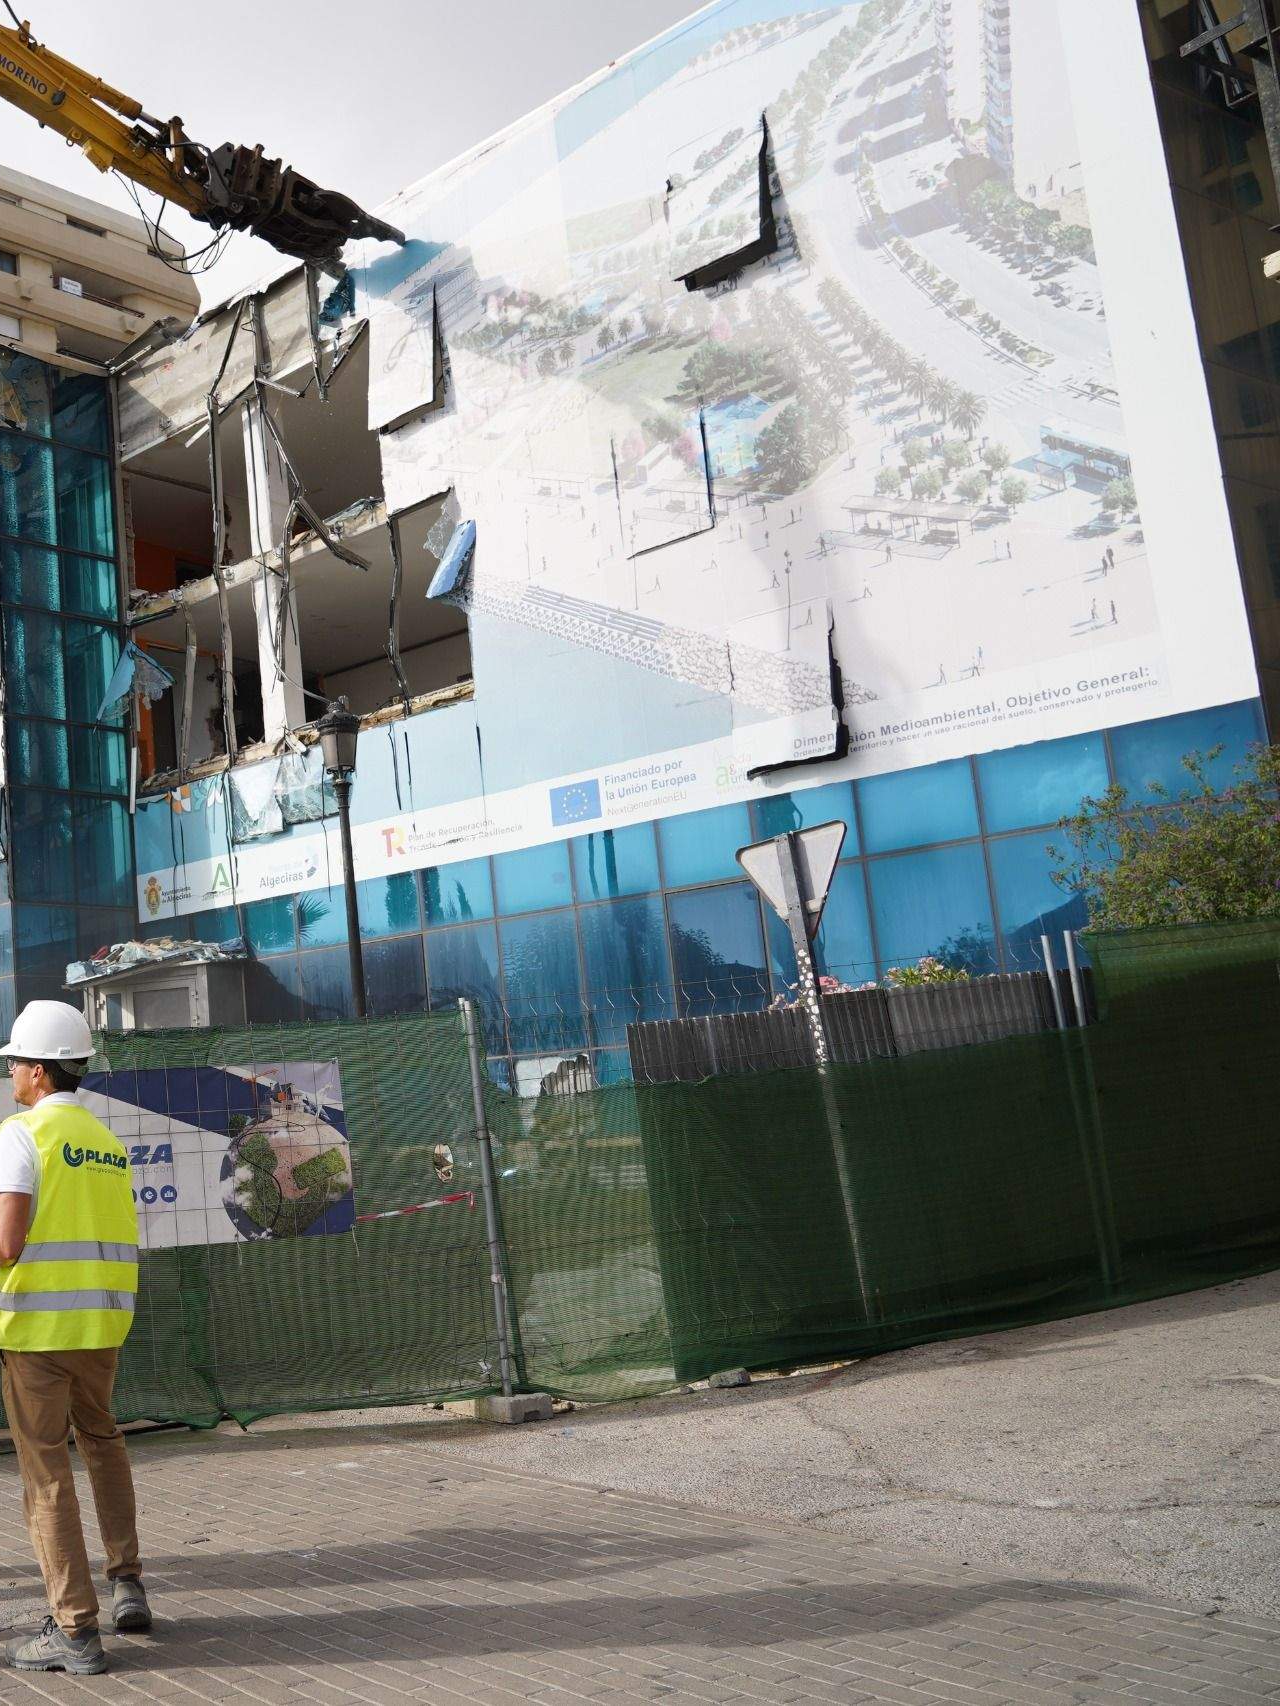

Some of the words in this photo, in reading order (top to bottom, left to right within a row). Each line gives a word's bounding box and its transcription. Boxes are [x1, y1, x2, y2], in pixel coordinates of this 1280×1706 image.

[880, 701, 1001, 736] Medioambiental,
[1006, 686, 1071, 709] Objetivo
[1077, 666, 1150, 692] General:
[850, 739, 887, 753] territorio
[896, 732, 920, 743] hacer
[952, 716, 989, 731] racional
[992, 713, 1006, 722] del
[1008, 707, 1037, 719] suelo,
[1104, 679, 1158, 698] protegerlo
[604, 763, 661, 785] Financiado
[664, 760, 683, 774] por
[605, 788, 615, 800] la
[618, 783, 648, 798] Unión
[651, 772, 697, 790] Europea
[426, 830, 436, 838] de
[438, 819, 495, 837] Recuperación,
[260, 872, 304, 889] Algeciras
[85, 1149, 127, 1169] PLAZA
[128, 1143, 173, 1166] ZA
